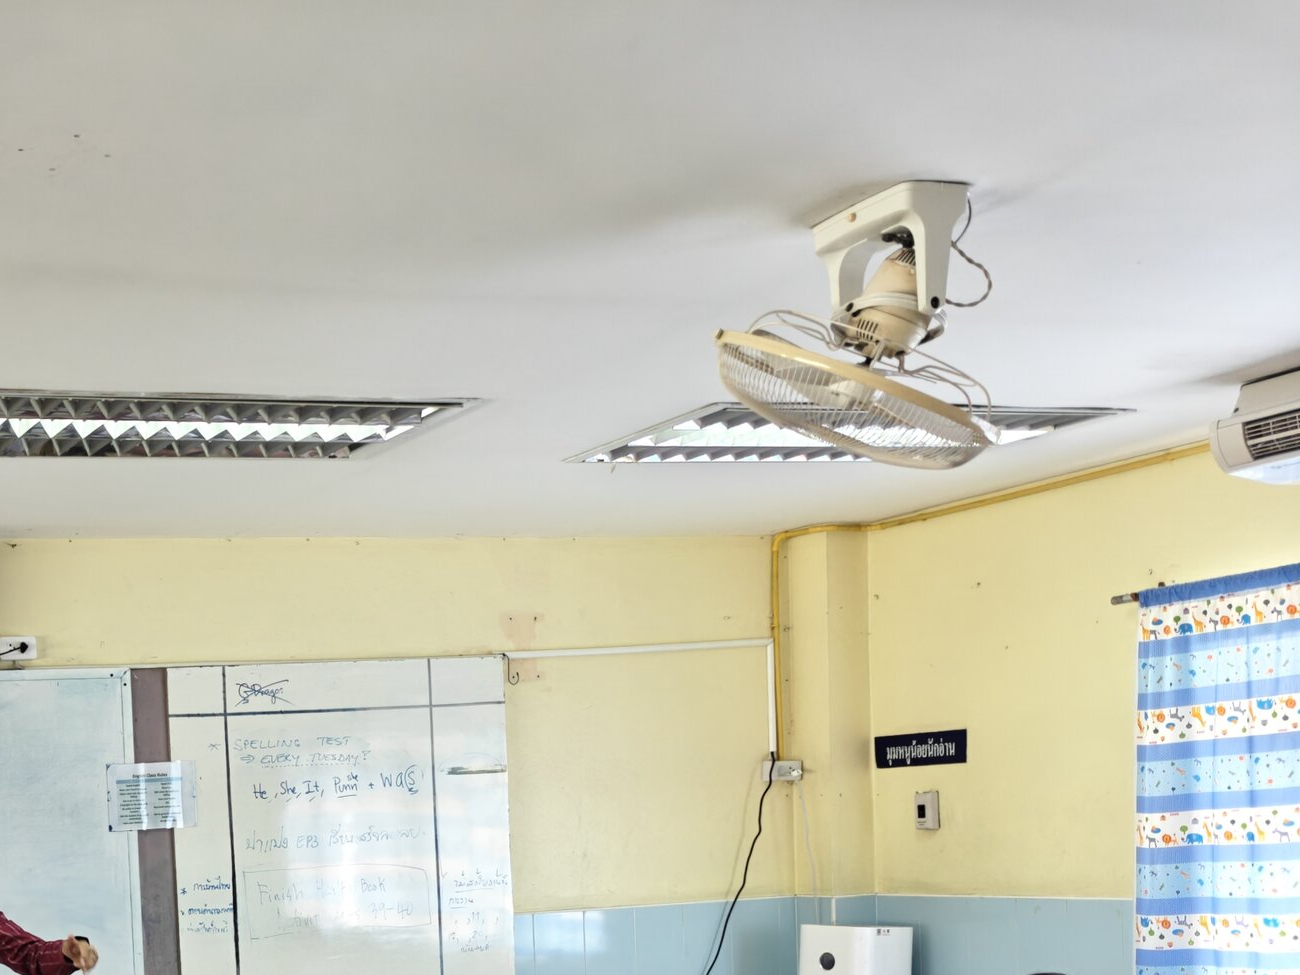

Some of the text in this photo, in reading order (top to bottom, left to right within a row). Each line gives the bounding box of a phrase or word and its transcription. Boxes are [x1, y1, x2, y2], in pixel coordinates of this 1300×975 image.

[233, 736, 351, 750] SPELLING TEST
[886, 738, 956, 766] มุมหนูน้อยนักอ่าน
[360, 876, 387, 892] Book
